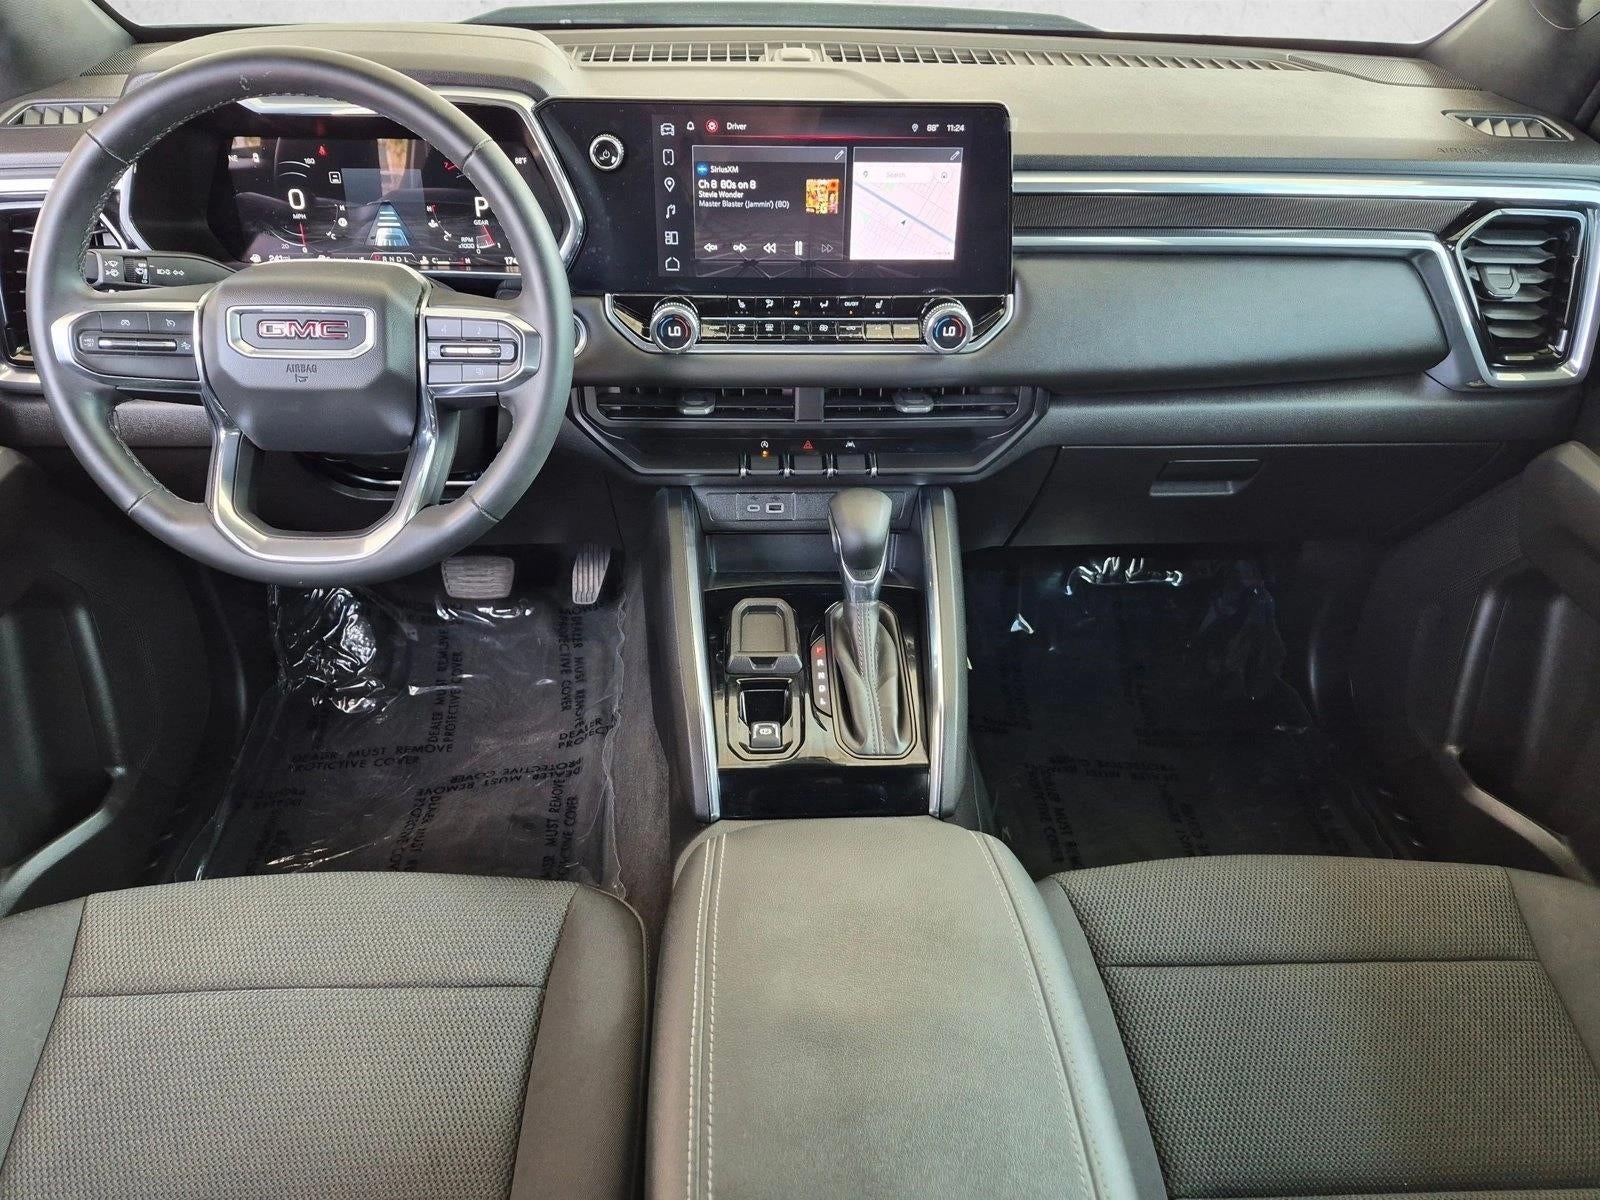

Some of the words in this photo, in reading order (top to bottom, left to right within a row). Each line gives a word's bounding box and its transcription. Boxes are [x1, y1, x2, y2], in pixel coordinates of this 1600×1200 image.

[726, 121, 747, 131] Driver
[946, 124, 965, 132] 11:24
[710, 165, 739, 174] SiriusXM
[697, 179, 710, 190] Ch
[710, 180, 718, 189] 8
[720, 180, 736, 190] 80s
[737, 182, 749, 190] on
[749, 180, 757, 190] 8
[287, 188, 306, 211] 0
[698, 190, 718, 199] Stevie
[718, 190, 744, 199] Wonder
[473, 196, 489, 218] P
[698, 200, 721, 208] Master
[721, 200, 744, 208] Blaster
[258, 320, 349, 339] GMC
[667, 325, 681, 337] LO
[942, 325, 956, 337] LO
[285, 364, 318, 373] AIRBAG
[451, 650, 463, 684] COVER
[348, 746, 387, 759] MUST
[396, 743, 454, 755] REMOVE
[373, 755, 420, 768] COVER
[503, 757, 584, 776] PROTECTIVE
[450, 770, 496, 784] COVER
[483, 774, 522, 787] MUST
[416, 781, 475, 797] REMOVE
[549, 778, 565, 814] REMOVE
